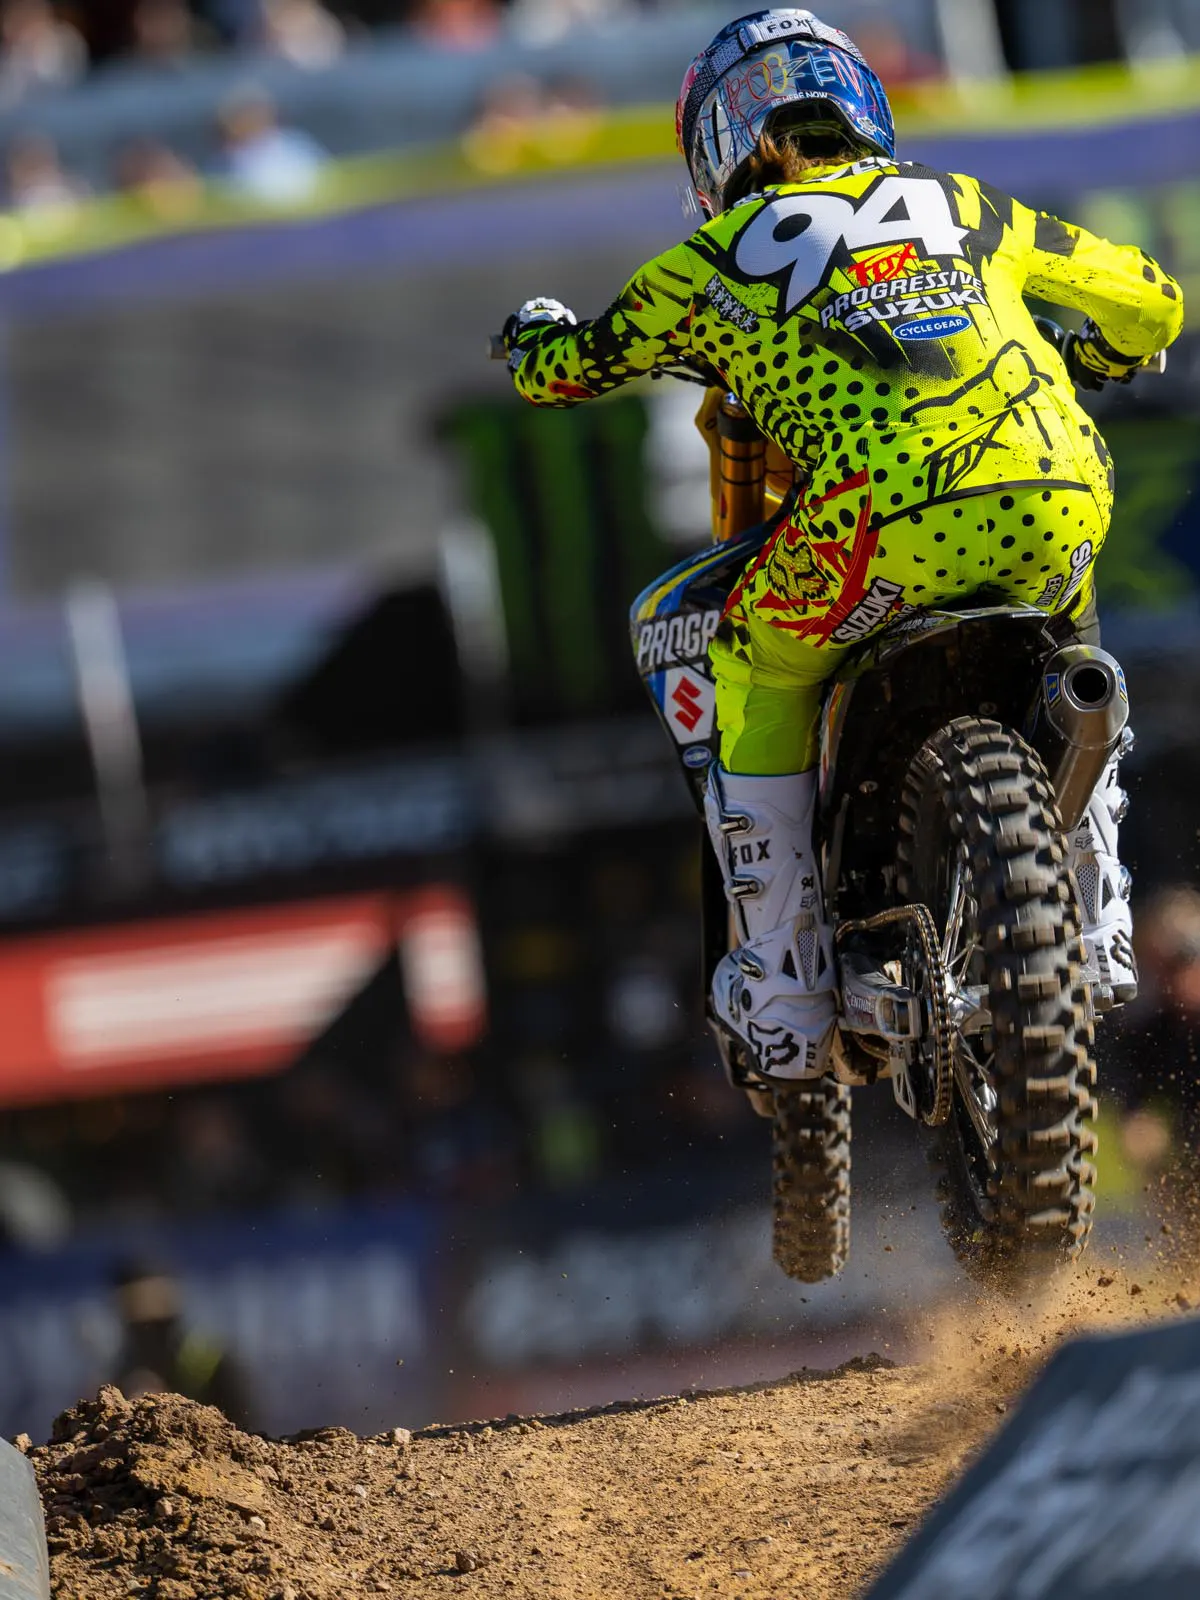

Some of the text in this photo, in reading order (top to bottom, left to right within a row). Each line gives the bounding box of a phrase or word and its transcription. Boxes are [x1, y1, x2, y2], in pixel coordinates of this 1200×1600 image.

[767, 18, 812, 34] FOX
[805, 91, 828, 99] NOW
[735, 176, 970, 314] 94
[820, 270, 983, 329] PROGRESSIVE
[844, 289, 988, 332] SUZUKI
[899, 318, 964, 337] CYCLE GEAR
[834, 578, 901, 641] SUZUKI
[806, 1041, 819, 1069] FOX
